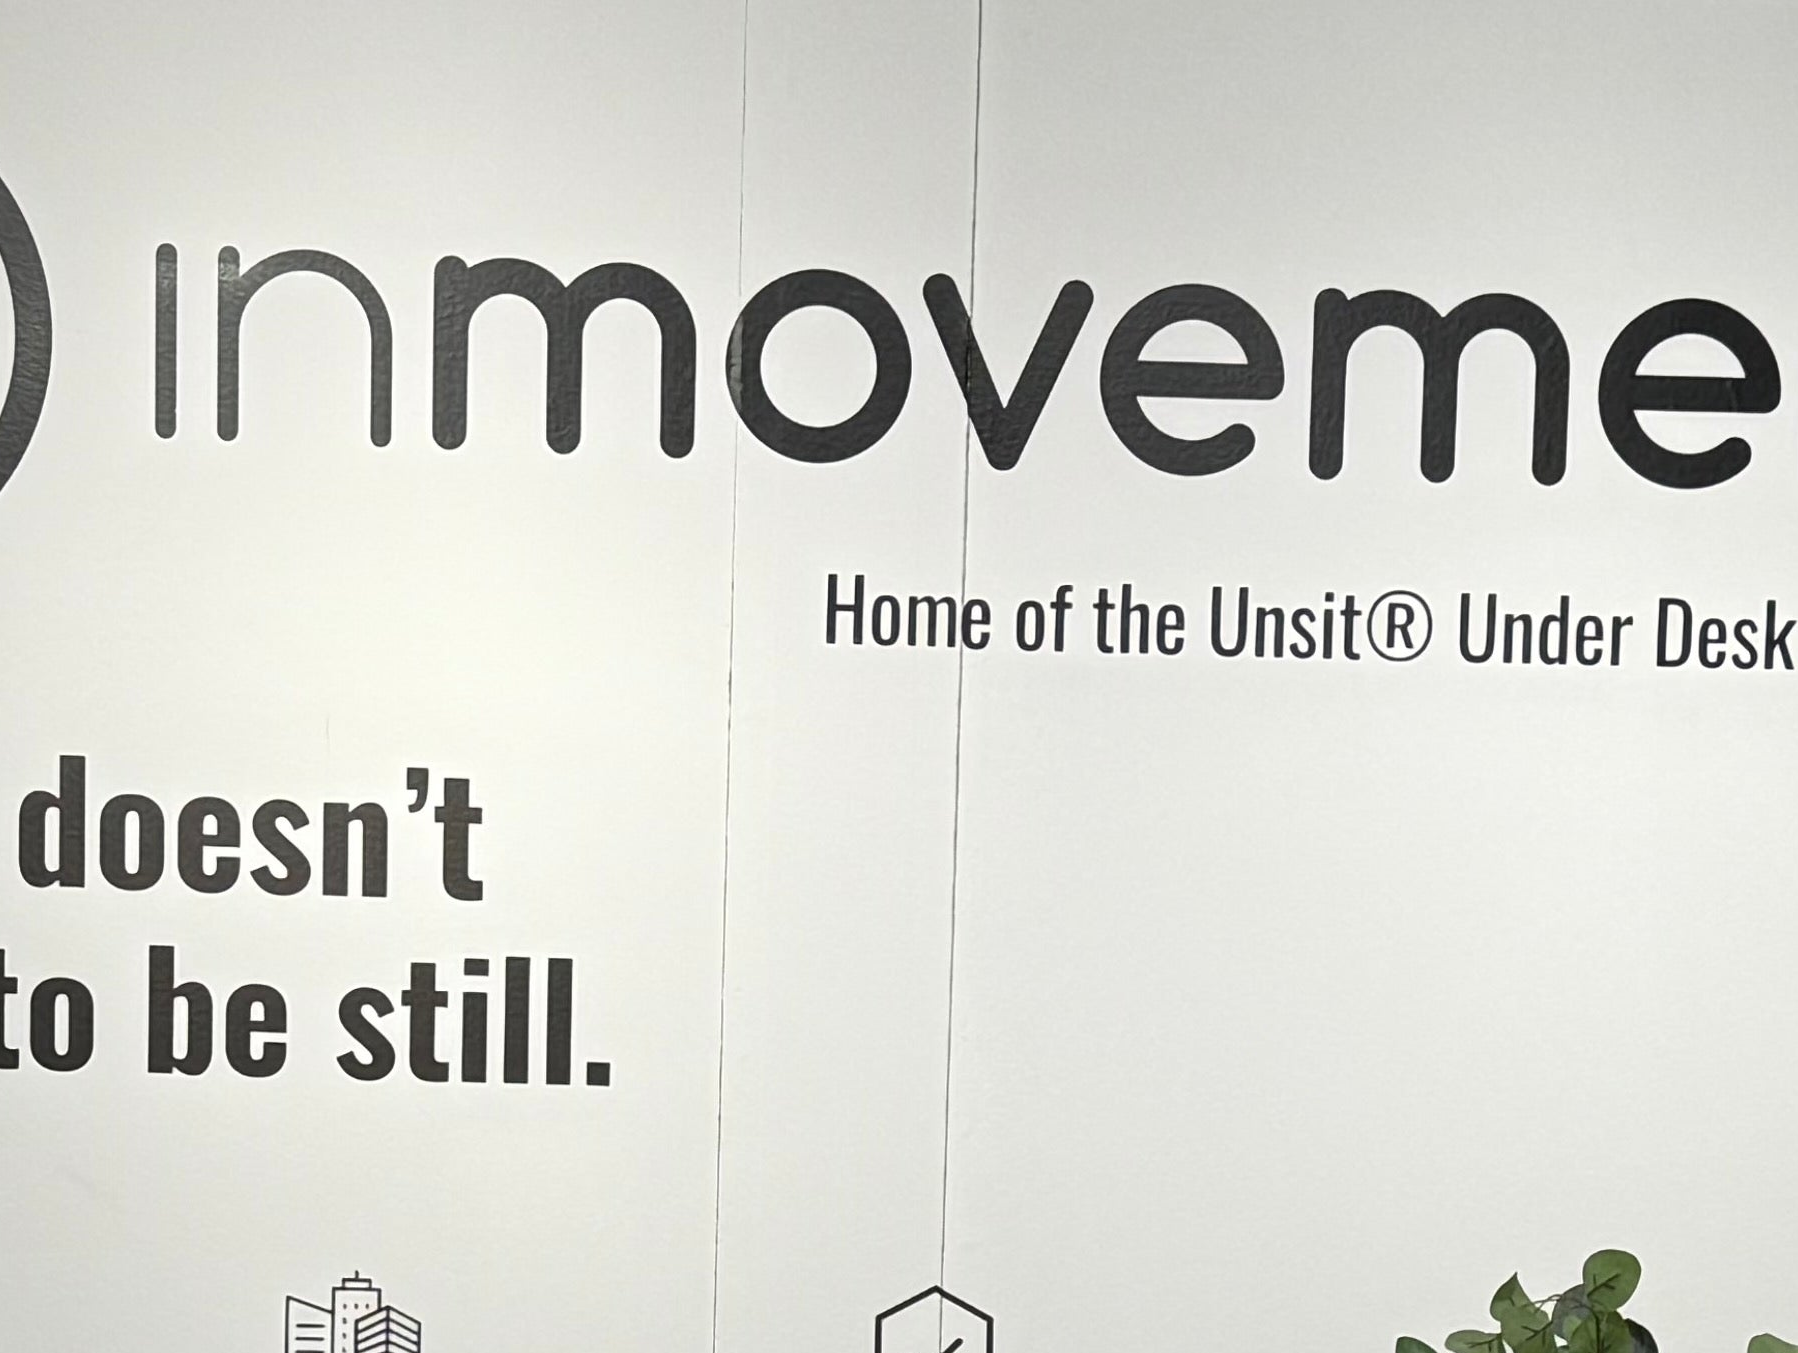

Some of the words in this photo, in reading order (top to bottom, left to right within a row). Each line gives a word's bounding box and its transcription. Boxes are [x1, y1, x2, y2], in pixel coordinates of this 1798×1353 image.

[826, 573, 991, 650] Home
[1016, 584, 1073, 652] of
[1092, 583, 1185, 656] the
[1459, 593, 1634, 666] Under
[1656, 597, 1797, 670] Desk
[18, 754, 483, 902] doesn't
[147, 945, 287, 1078] be
[336, 956, 611, 1087] still.
